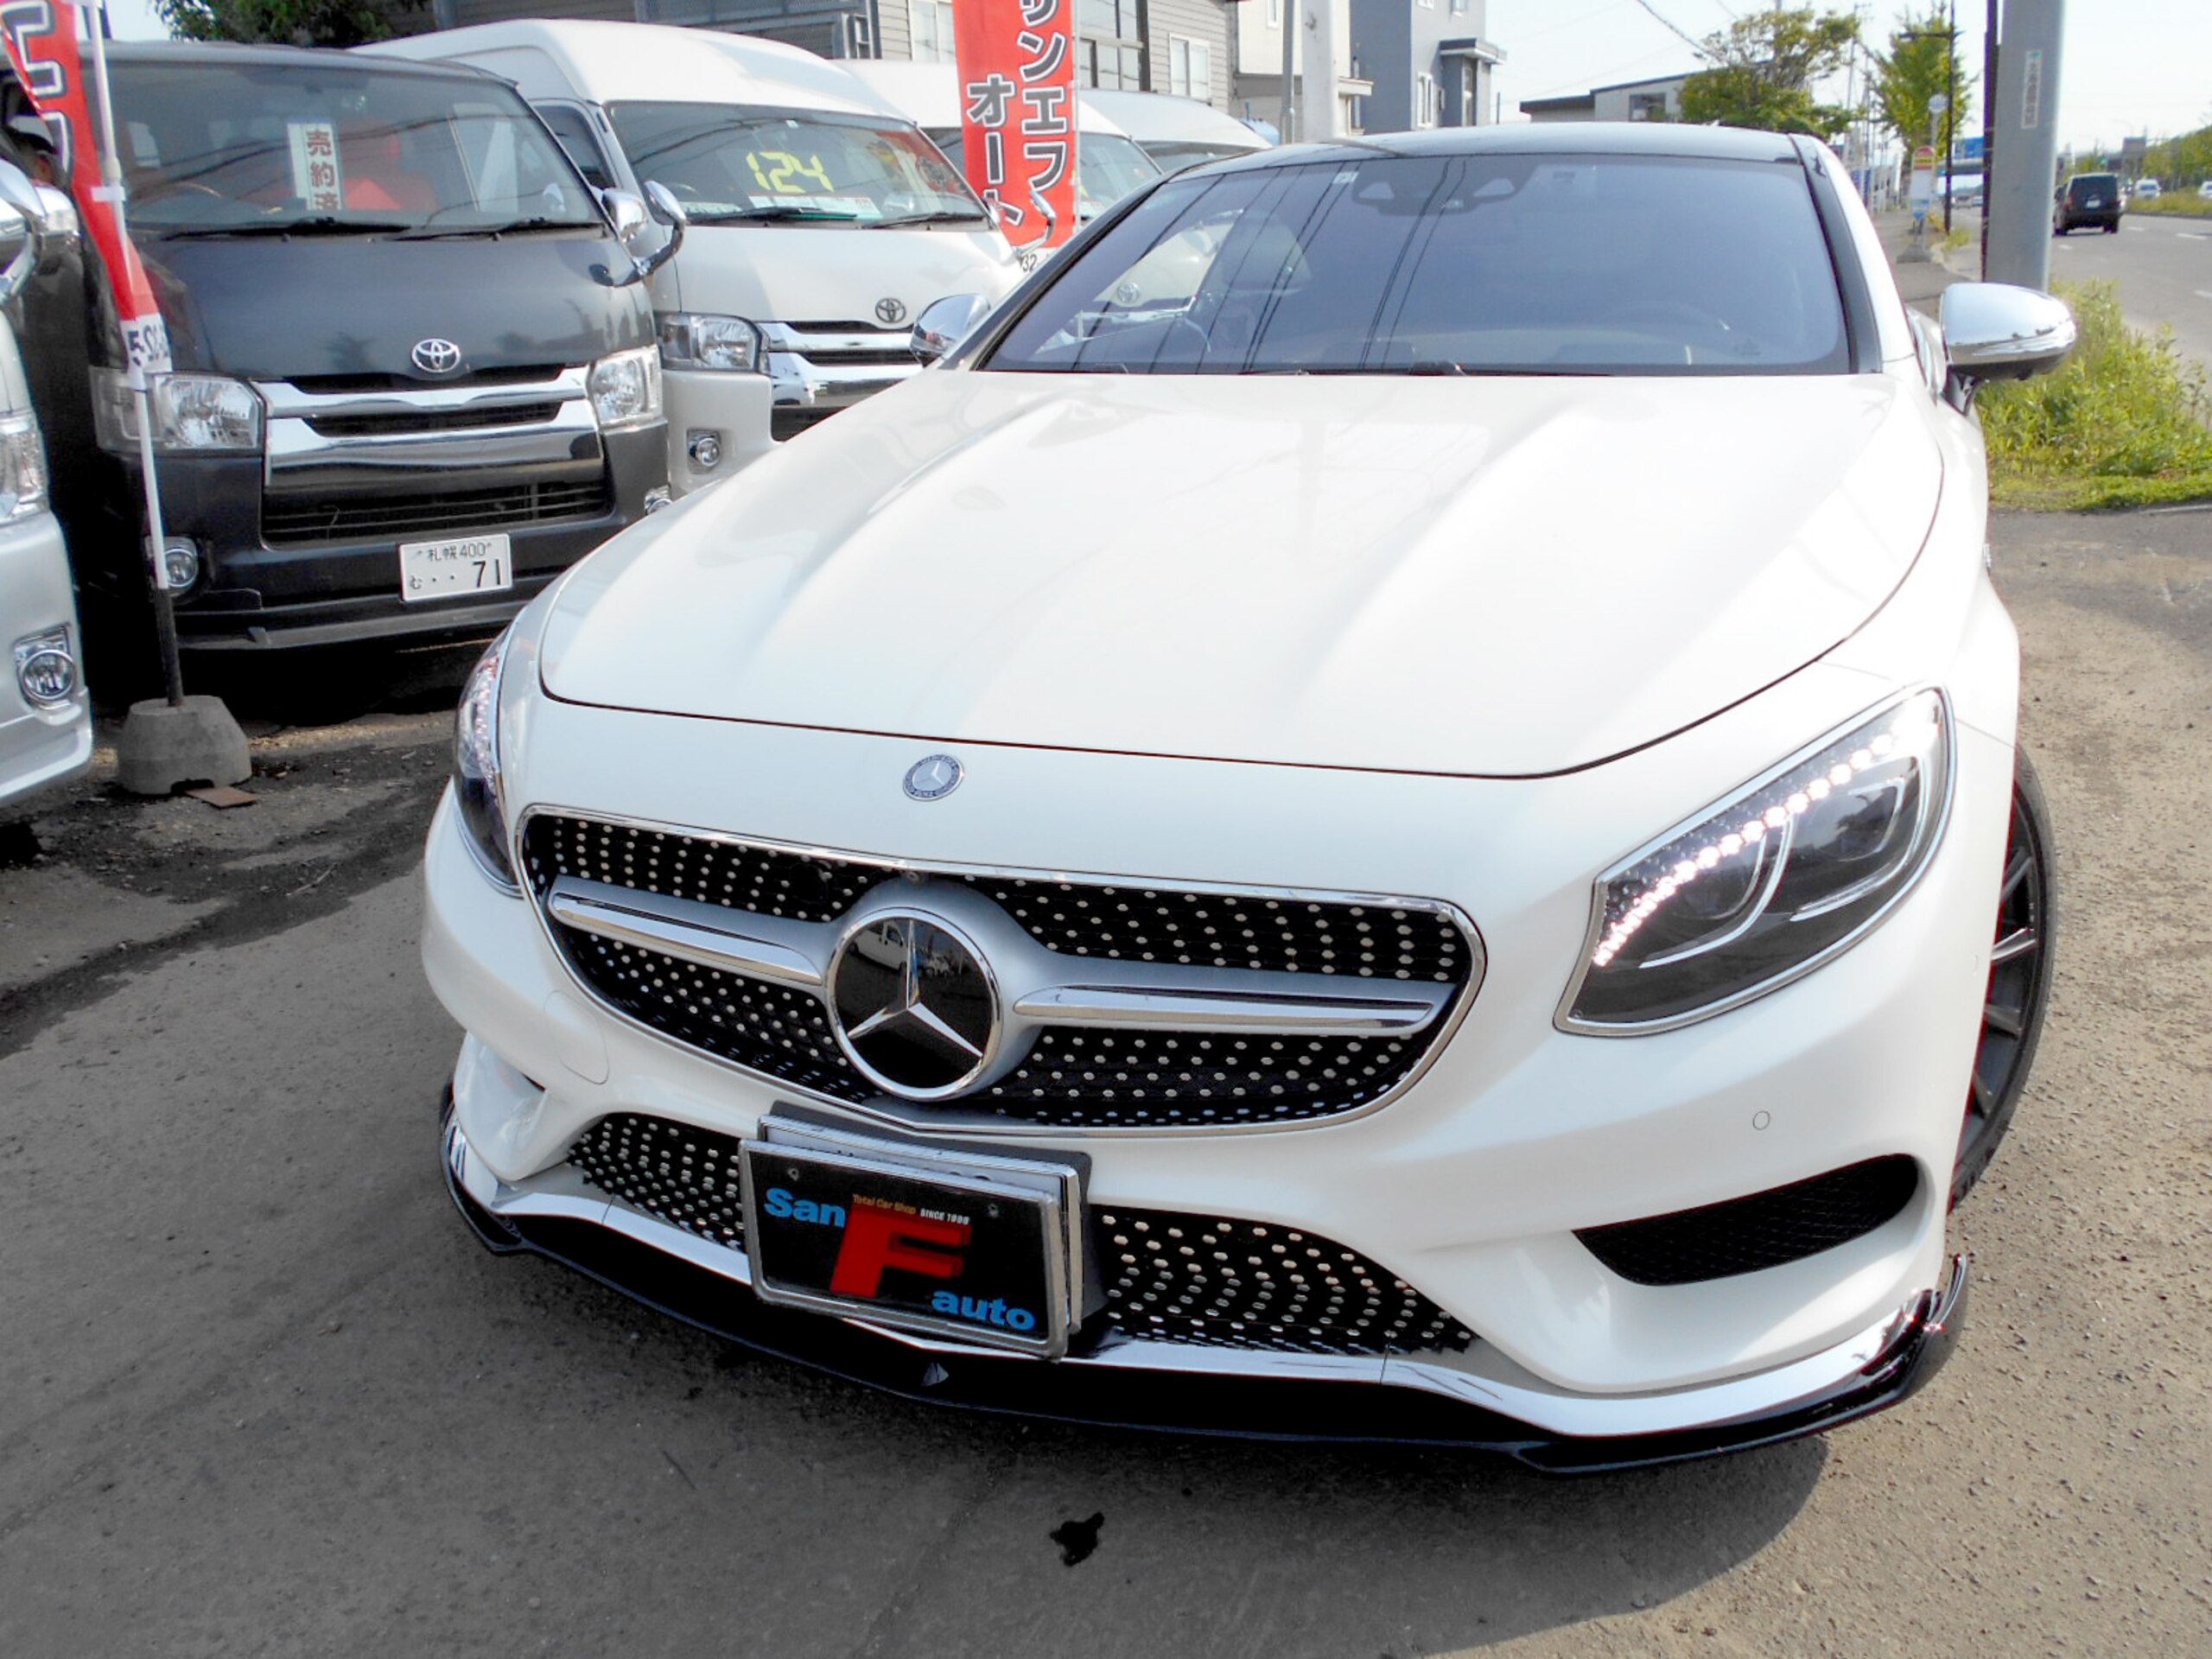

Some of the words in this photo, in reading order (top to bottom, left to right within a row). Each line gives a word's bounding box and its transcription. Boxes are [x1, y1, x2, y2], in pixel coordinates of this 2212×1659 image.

[747, 151, 835, 194] 124
[764, 1187, 847, 1229] San
[830, 1203, 974, 1300] F
[931, 1290, 1037, 1330] auto
